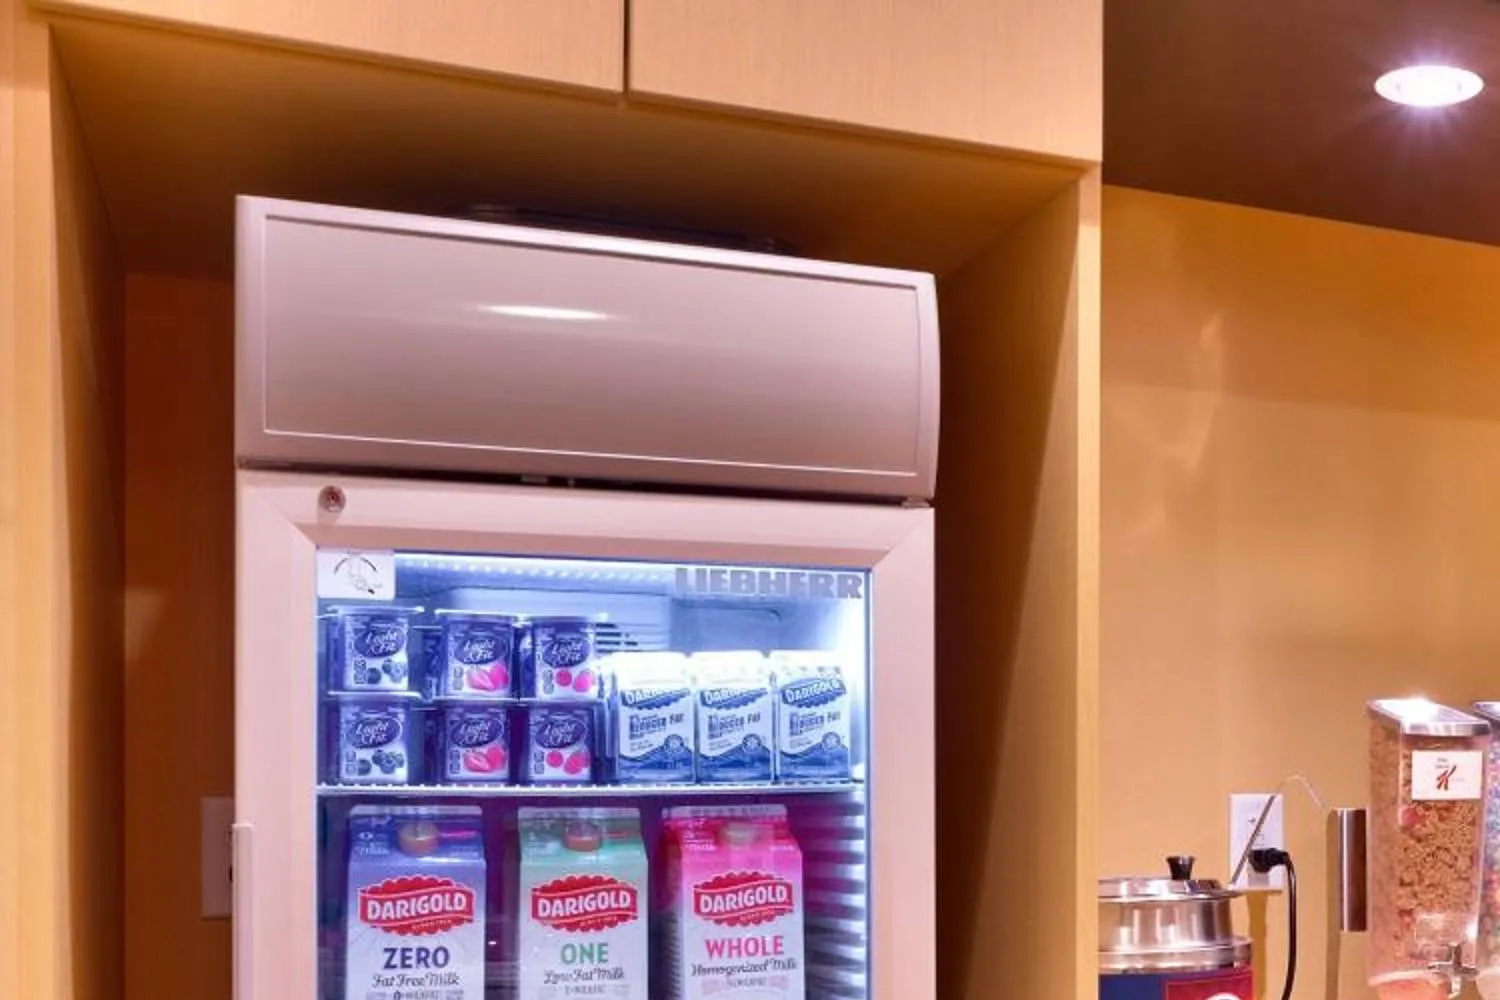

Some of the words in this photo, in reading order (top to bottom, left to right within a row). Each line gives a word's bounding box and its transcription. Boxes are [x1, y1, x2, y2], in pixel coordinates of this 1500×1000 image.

[675, 567, 863, 599] LIEBHERR
[367, 891, 467, 920] DARIGOLD
[538, 889, 631, 917] DARIGOLD
[700, 885, 787, 913] DARIGOLD
[383, 946, 450, 969] ZERO
[560, 942, 608, 964] ONE
[705, 935, 785, 960] WHOLE
[371, 973, 395, 988] Fat
[396, 972, 425, 987] Free
[426, 971, 461, 986] Milk
